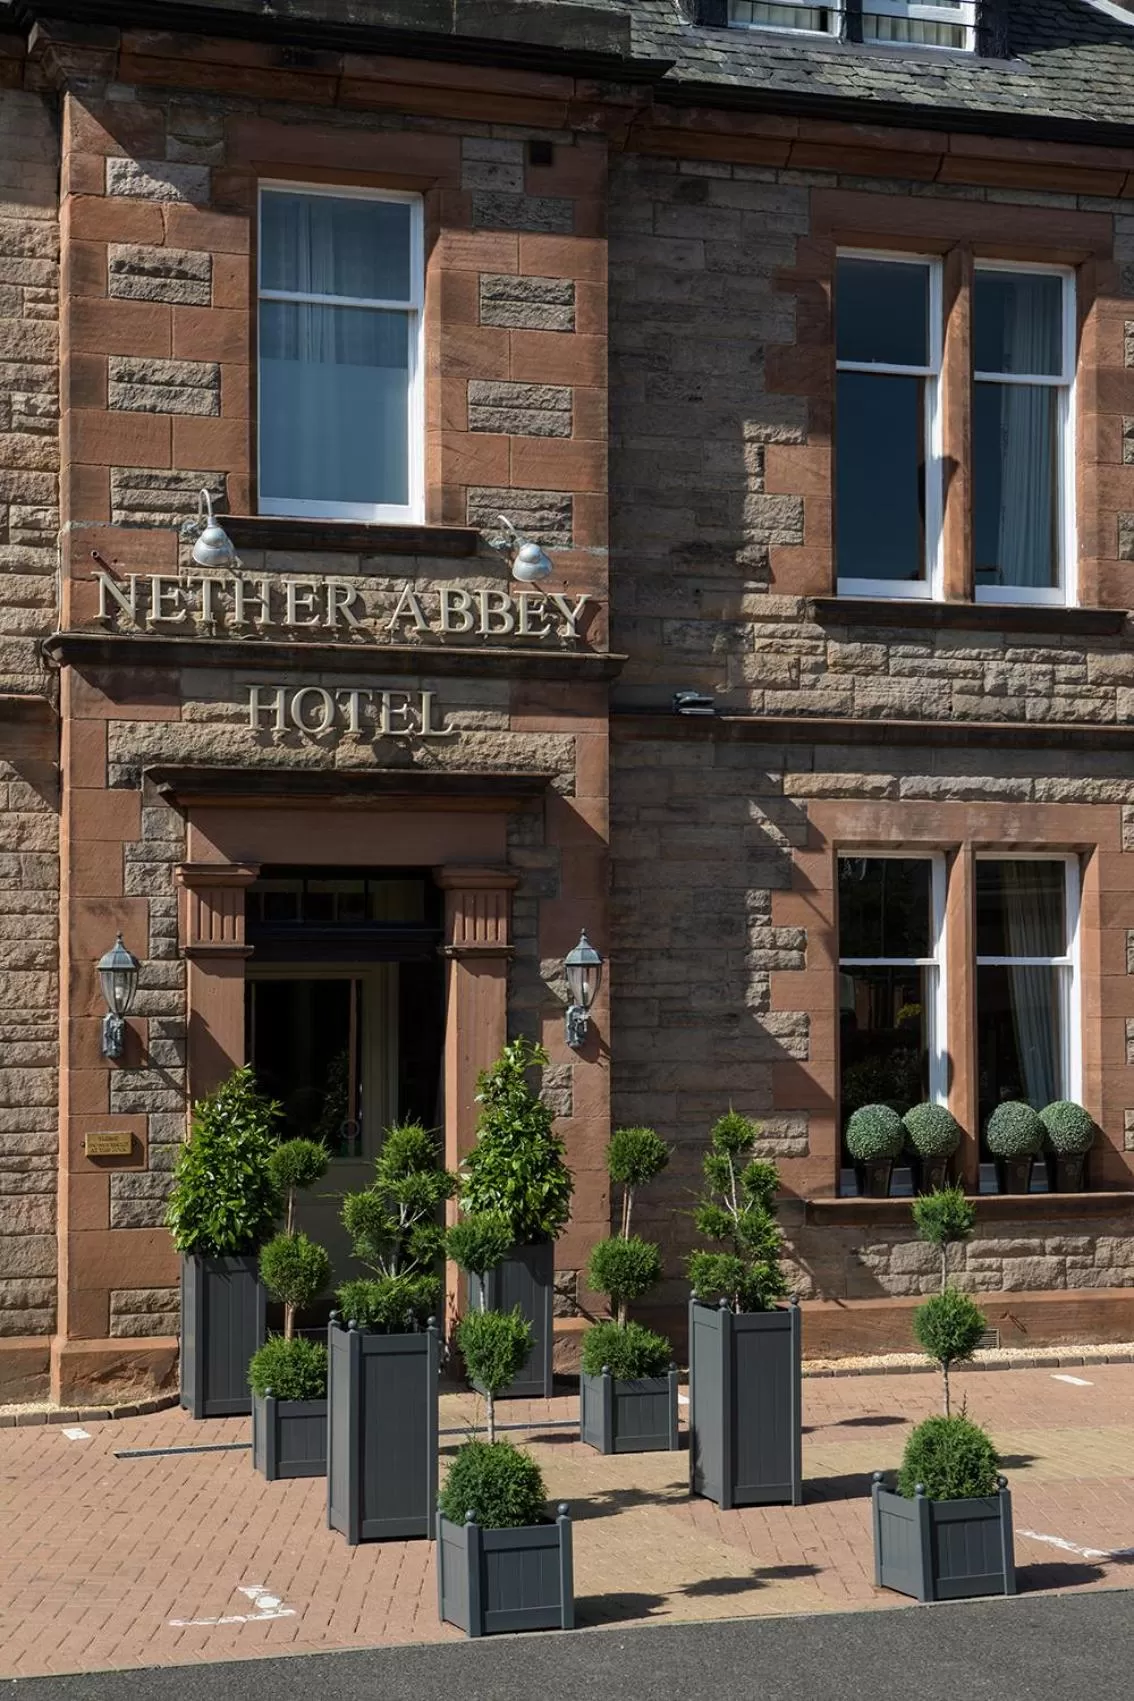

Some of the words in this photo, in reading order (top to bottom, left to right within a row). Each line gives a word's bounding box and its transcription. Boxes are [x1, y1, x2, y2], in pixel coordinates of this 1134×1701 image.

[91, 571, 367, 630] NETHER
[385, 583, 592, 639] ABBEY
[245, 685, 455, 737] HOTEL
